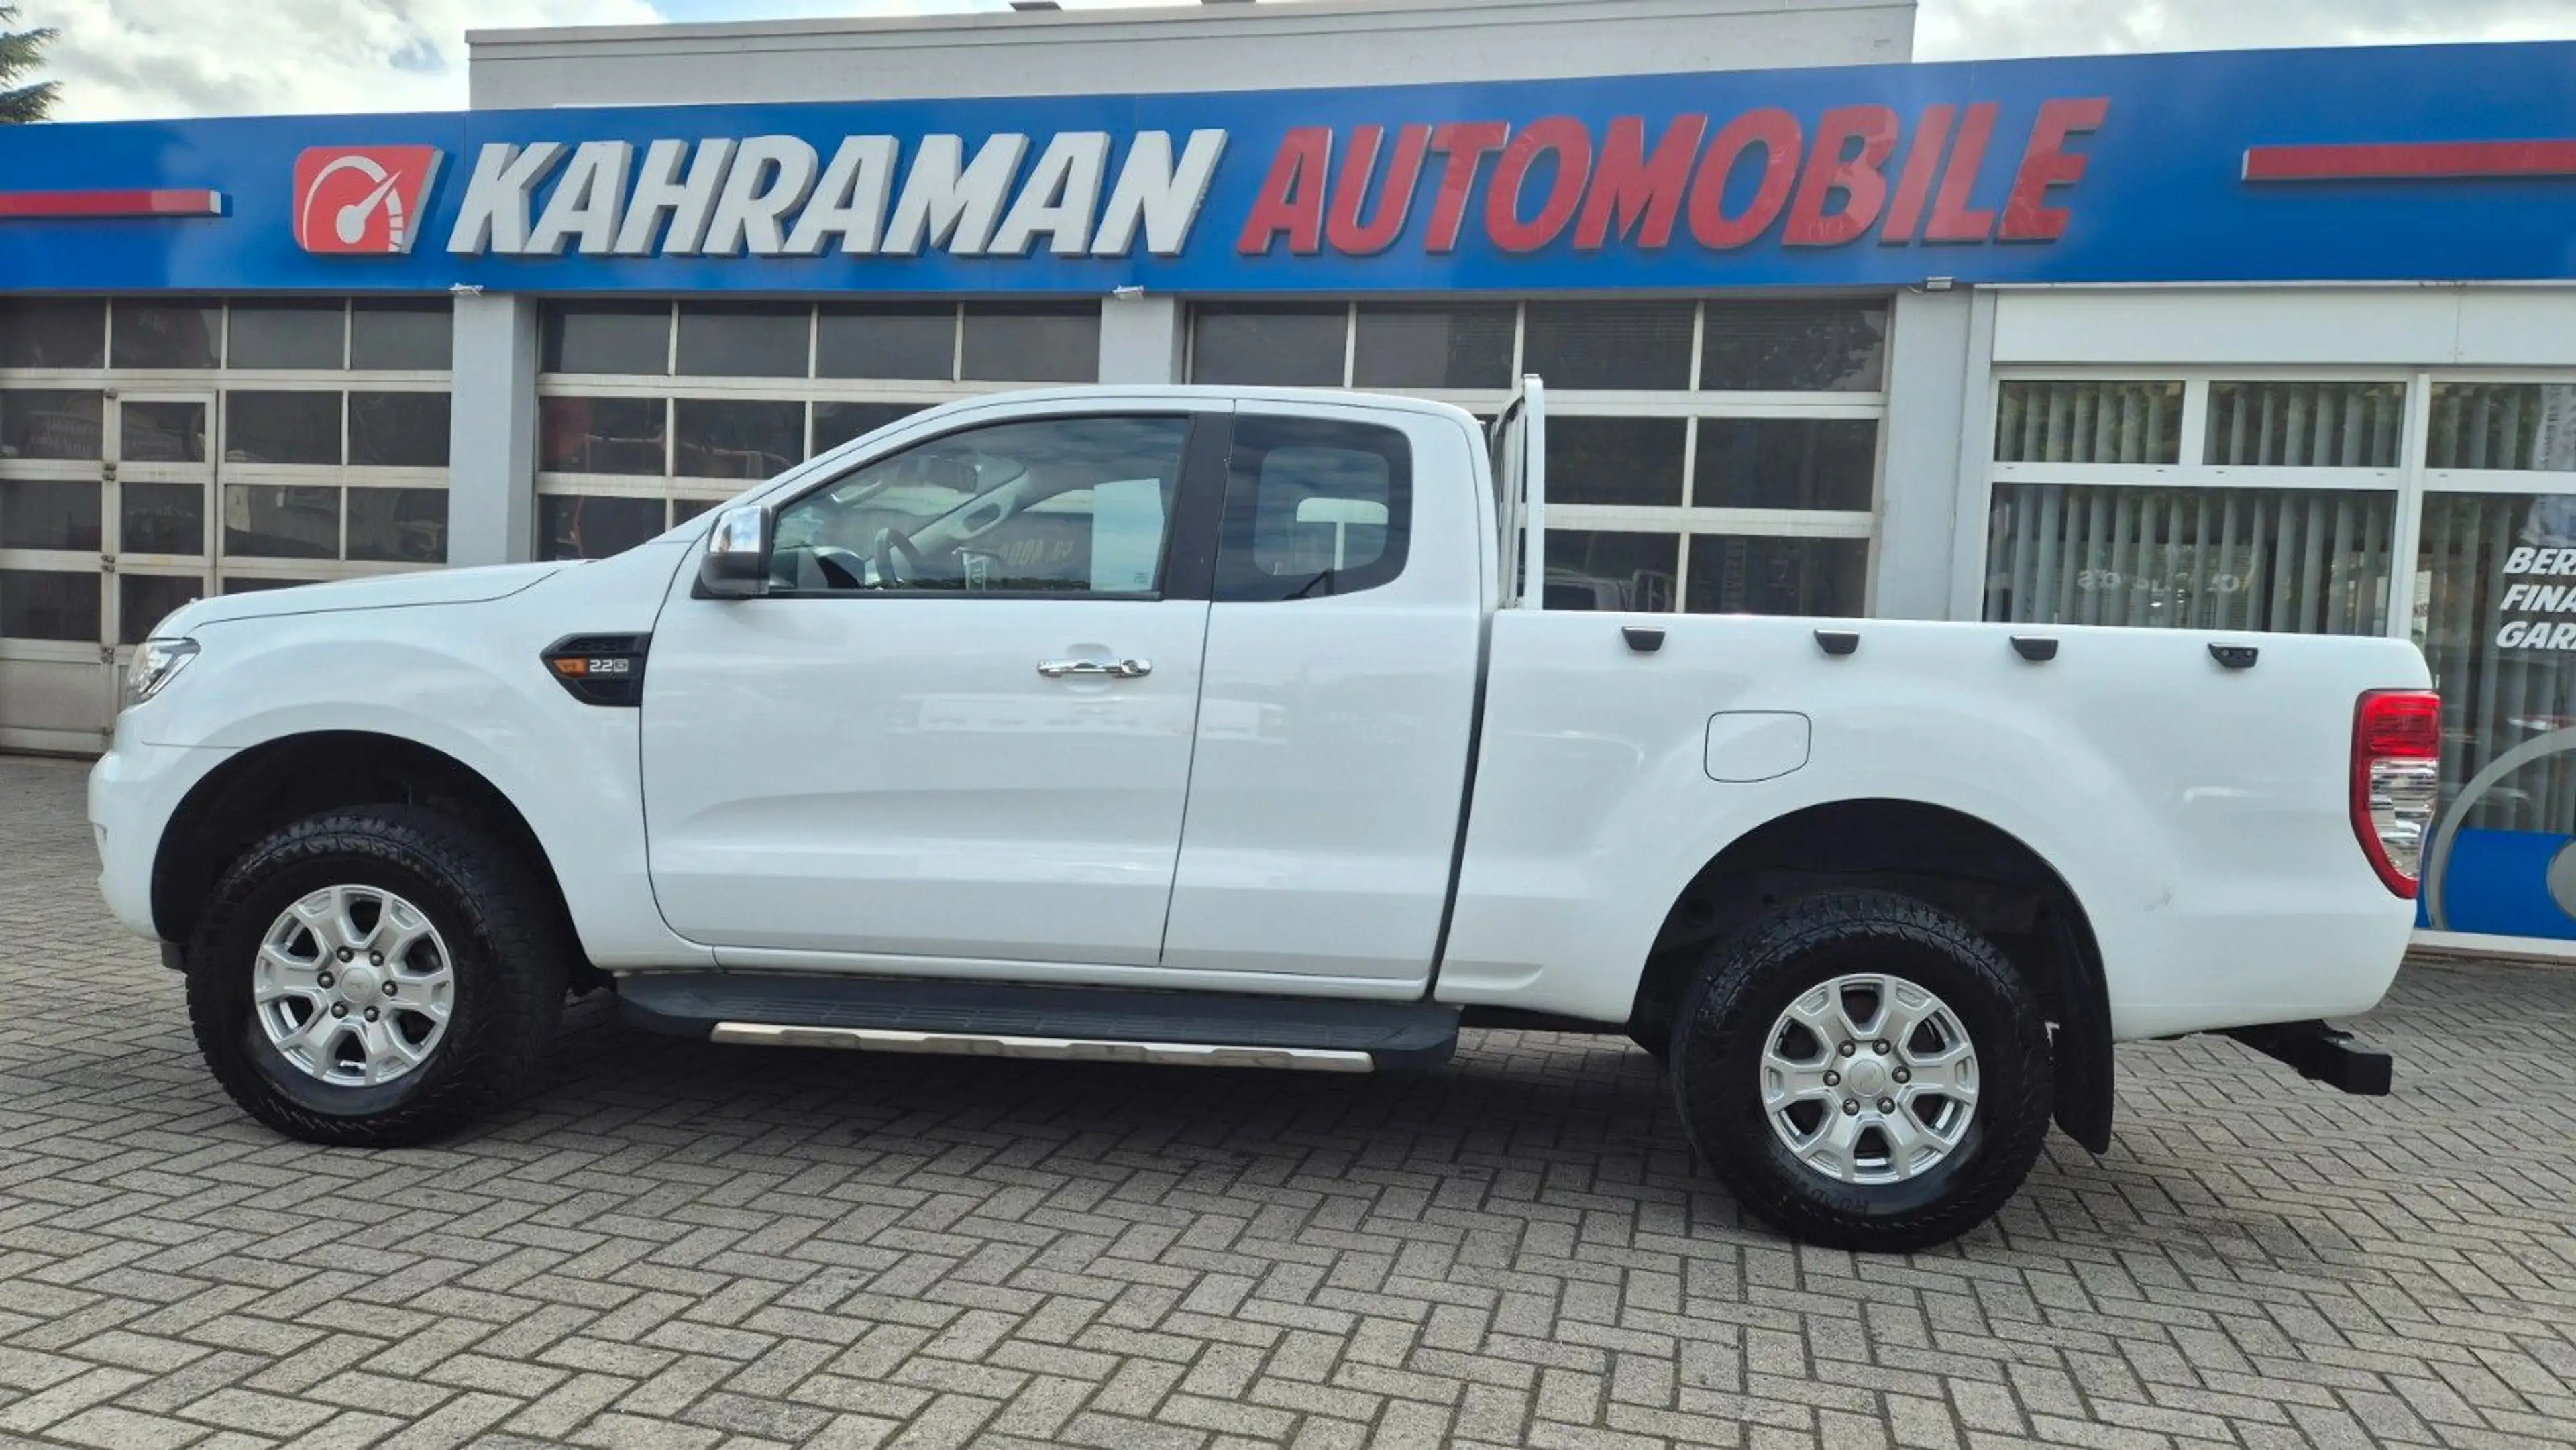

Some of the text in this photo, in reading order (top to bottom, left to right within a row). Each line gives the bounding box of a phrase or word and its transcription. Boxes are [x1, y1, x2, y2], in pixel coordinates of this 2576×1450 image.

[445, 96, 2110, 256] KAHRAMAN AUTOMOBILE
[2502, 547, 2576, 575] BER
[2496, 620, 2576, 650] GAR
